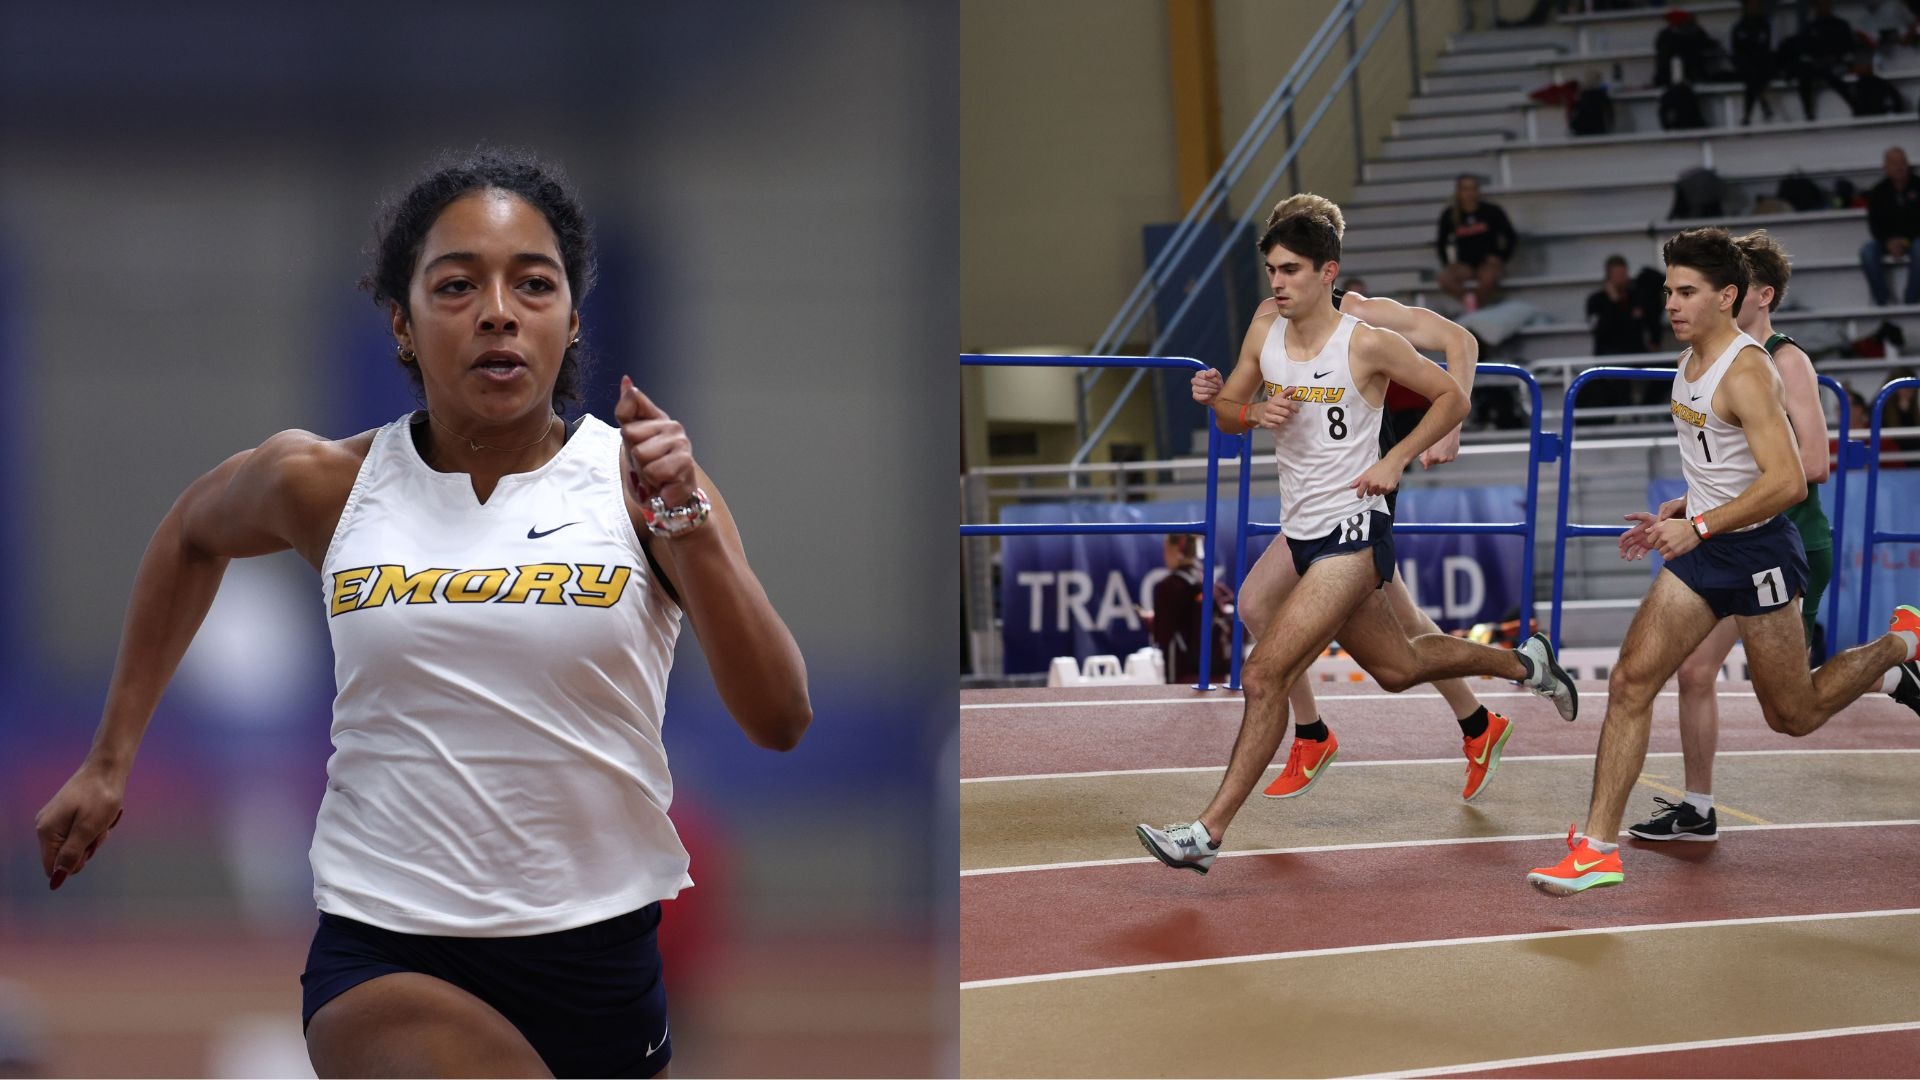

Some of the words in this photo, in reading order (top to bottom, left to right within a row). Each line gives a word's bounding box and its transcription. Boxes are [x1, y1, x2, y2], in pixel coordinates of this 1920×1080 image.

[1327, 406, 1347, 440] 8
[1671, 398, 1707, 428] MORY
[1697, 431, 1712, 462] 1
[1345, 512, 1364, 542] 8
[331, 562, 632, 618] EMORY
[1017, 565, 1226, 632] TRA
[1762, 571, 1779, 603] 1
